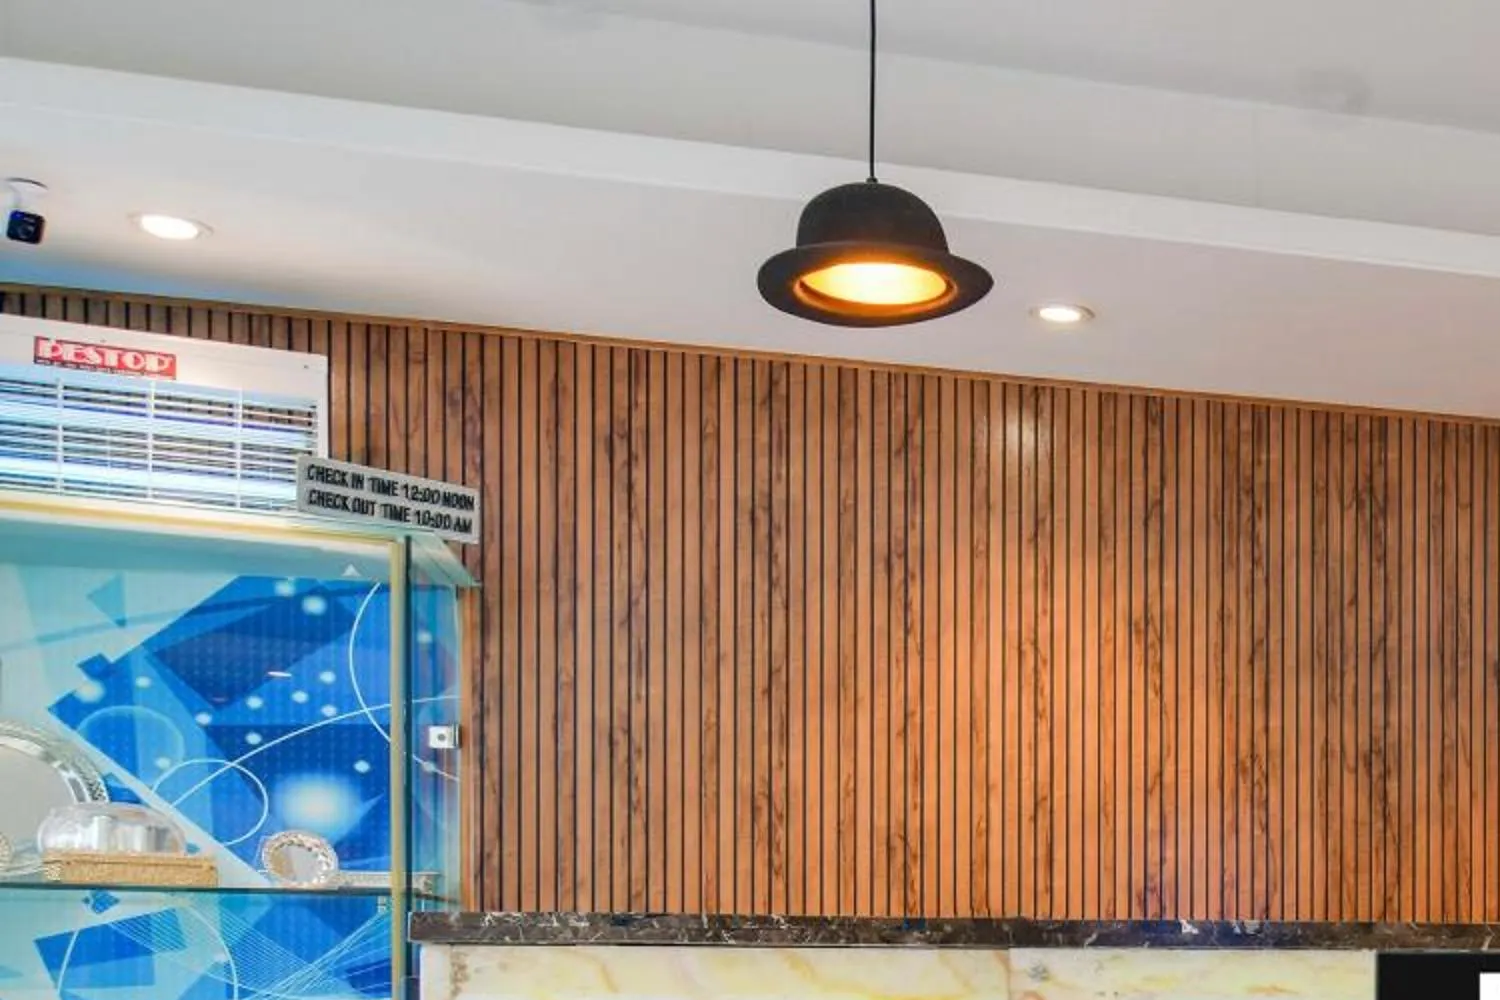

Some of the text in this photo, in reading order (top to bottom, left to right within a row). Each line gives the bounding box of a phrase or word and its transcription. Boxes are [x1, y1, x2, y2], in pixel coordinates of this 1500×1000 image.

[307, 463, 475, 511] CHECK IN TIME 12:00 NOON
[309, 489, 473, 534] CHECK OUT TIME 10:00 AM
